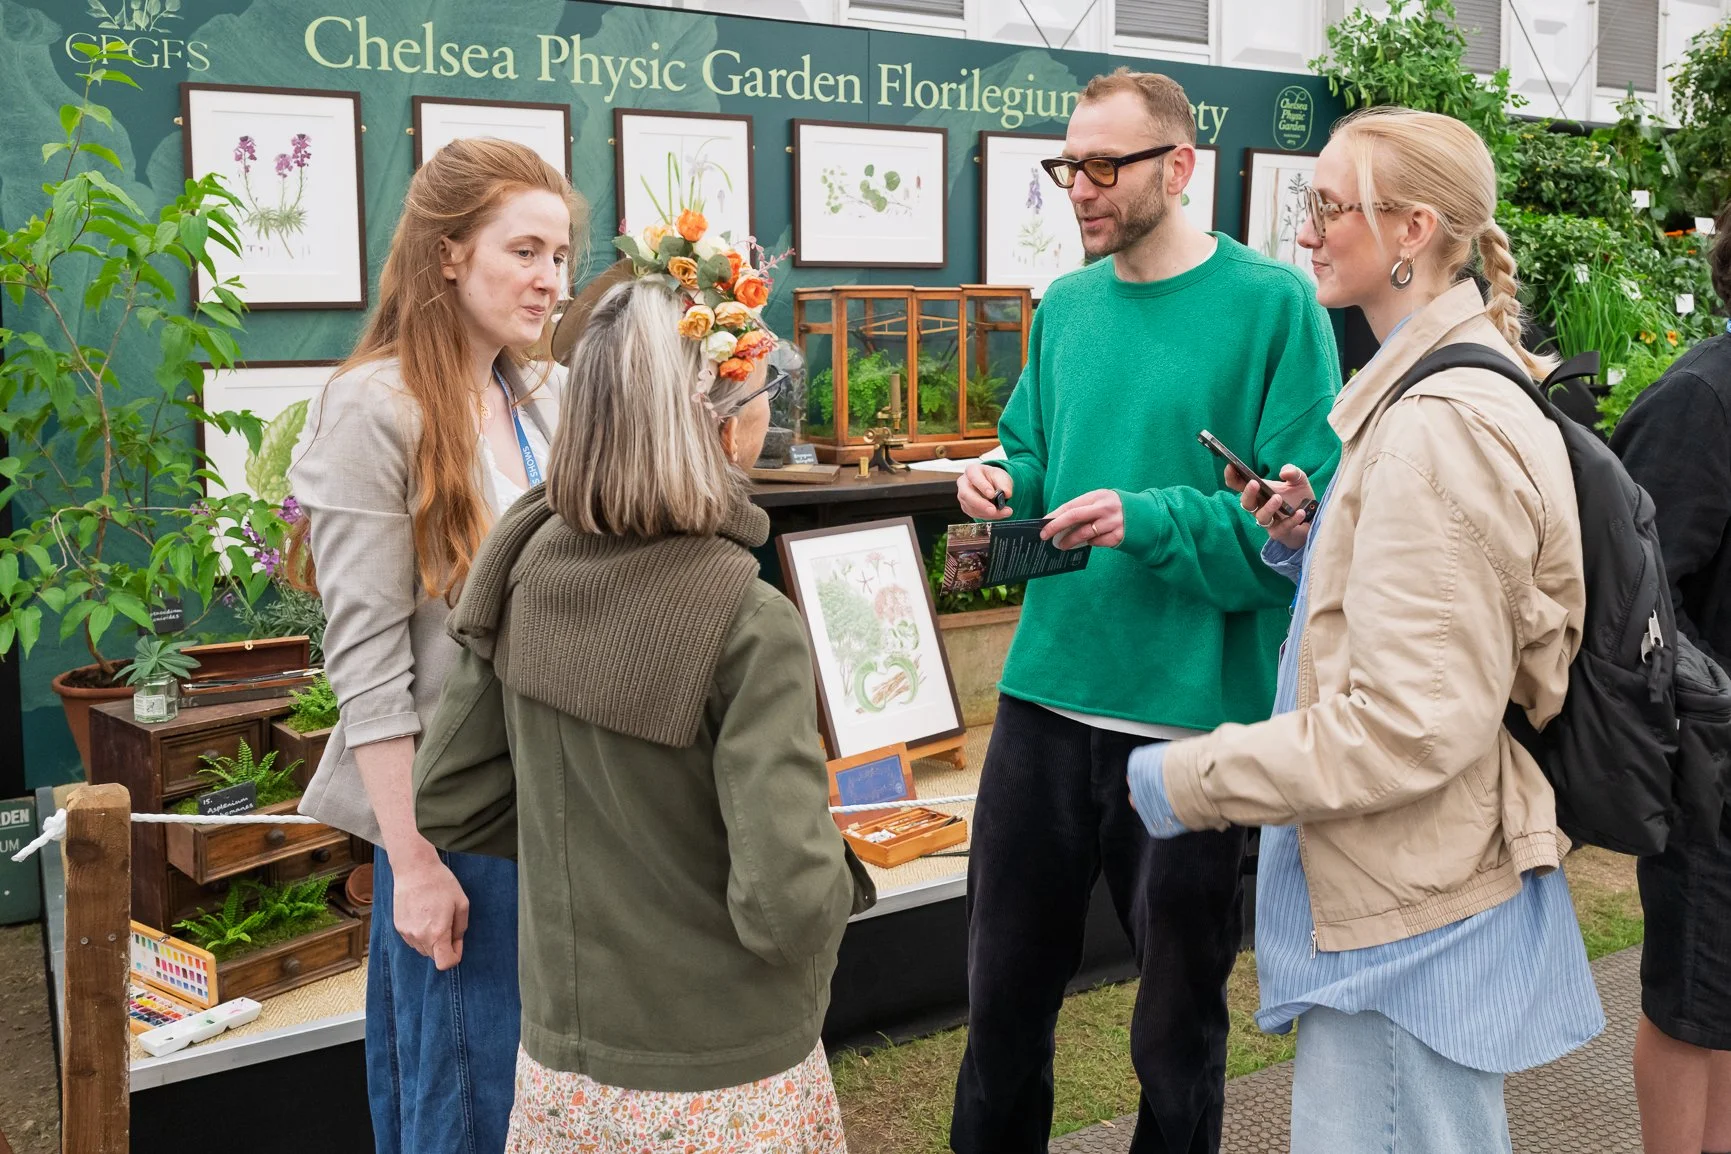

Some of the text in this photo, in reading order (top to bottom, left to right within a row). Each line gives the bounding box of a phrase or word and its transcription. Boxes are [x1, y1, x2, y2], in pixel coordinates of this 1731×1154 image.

[304, 15, 519, 80] Chelsea
[537, 33, 687, 103] Physic
[702, 49, 863, 104] Garden
[1279, 119, 1306, 132] Garden
[522, 445, 538, 478] SHOWS
[0, 808, 30, 827] DEN
